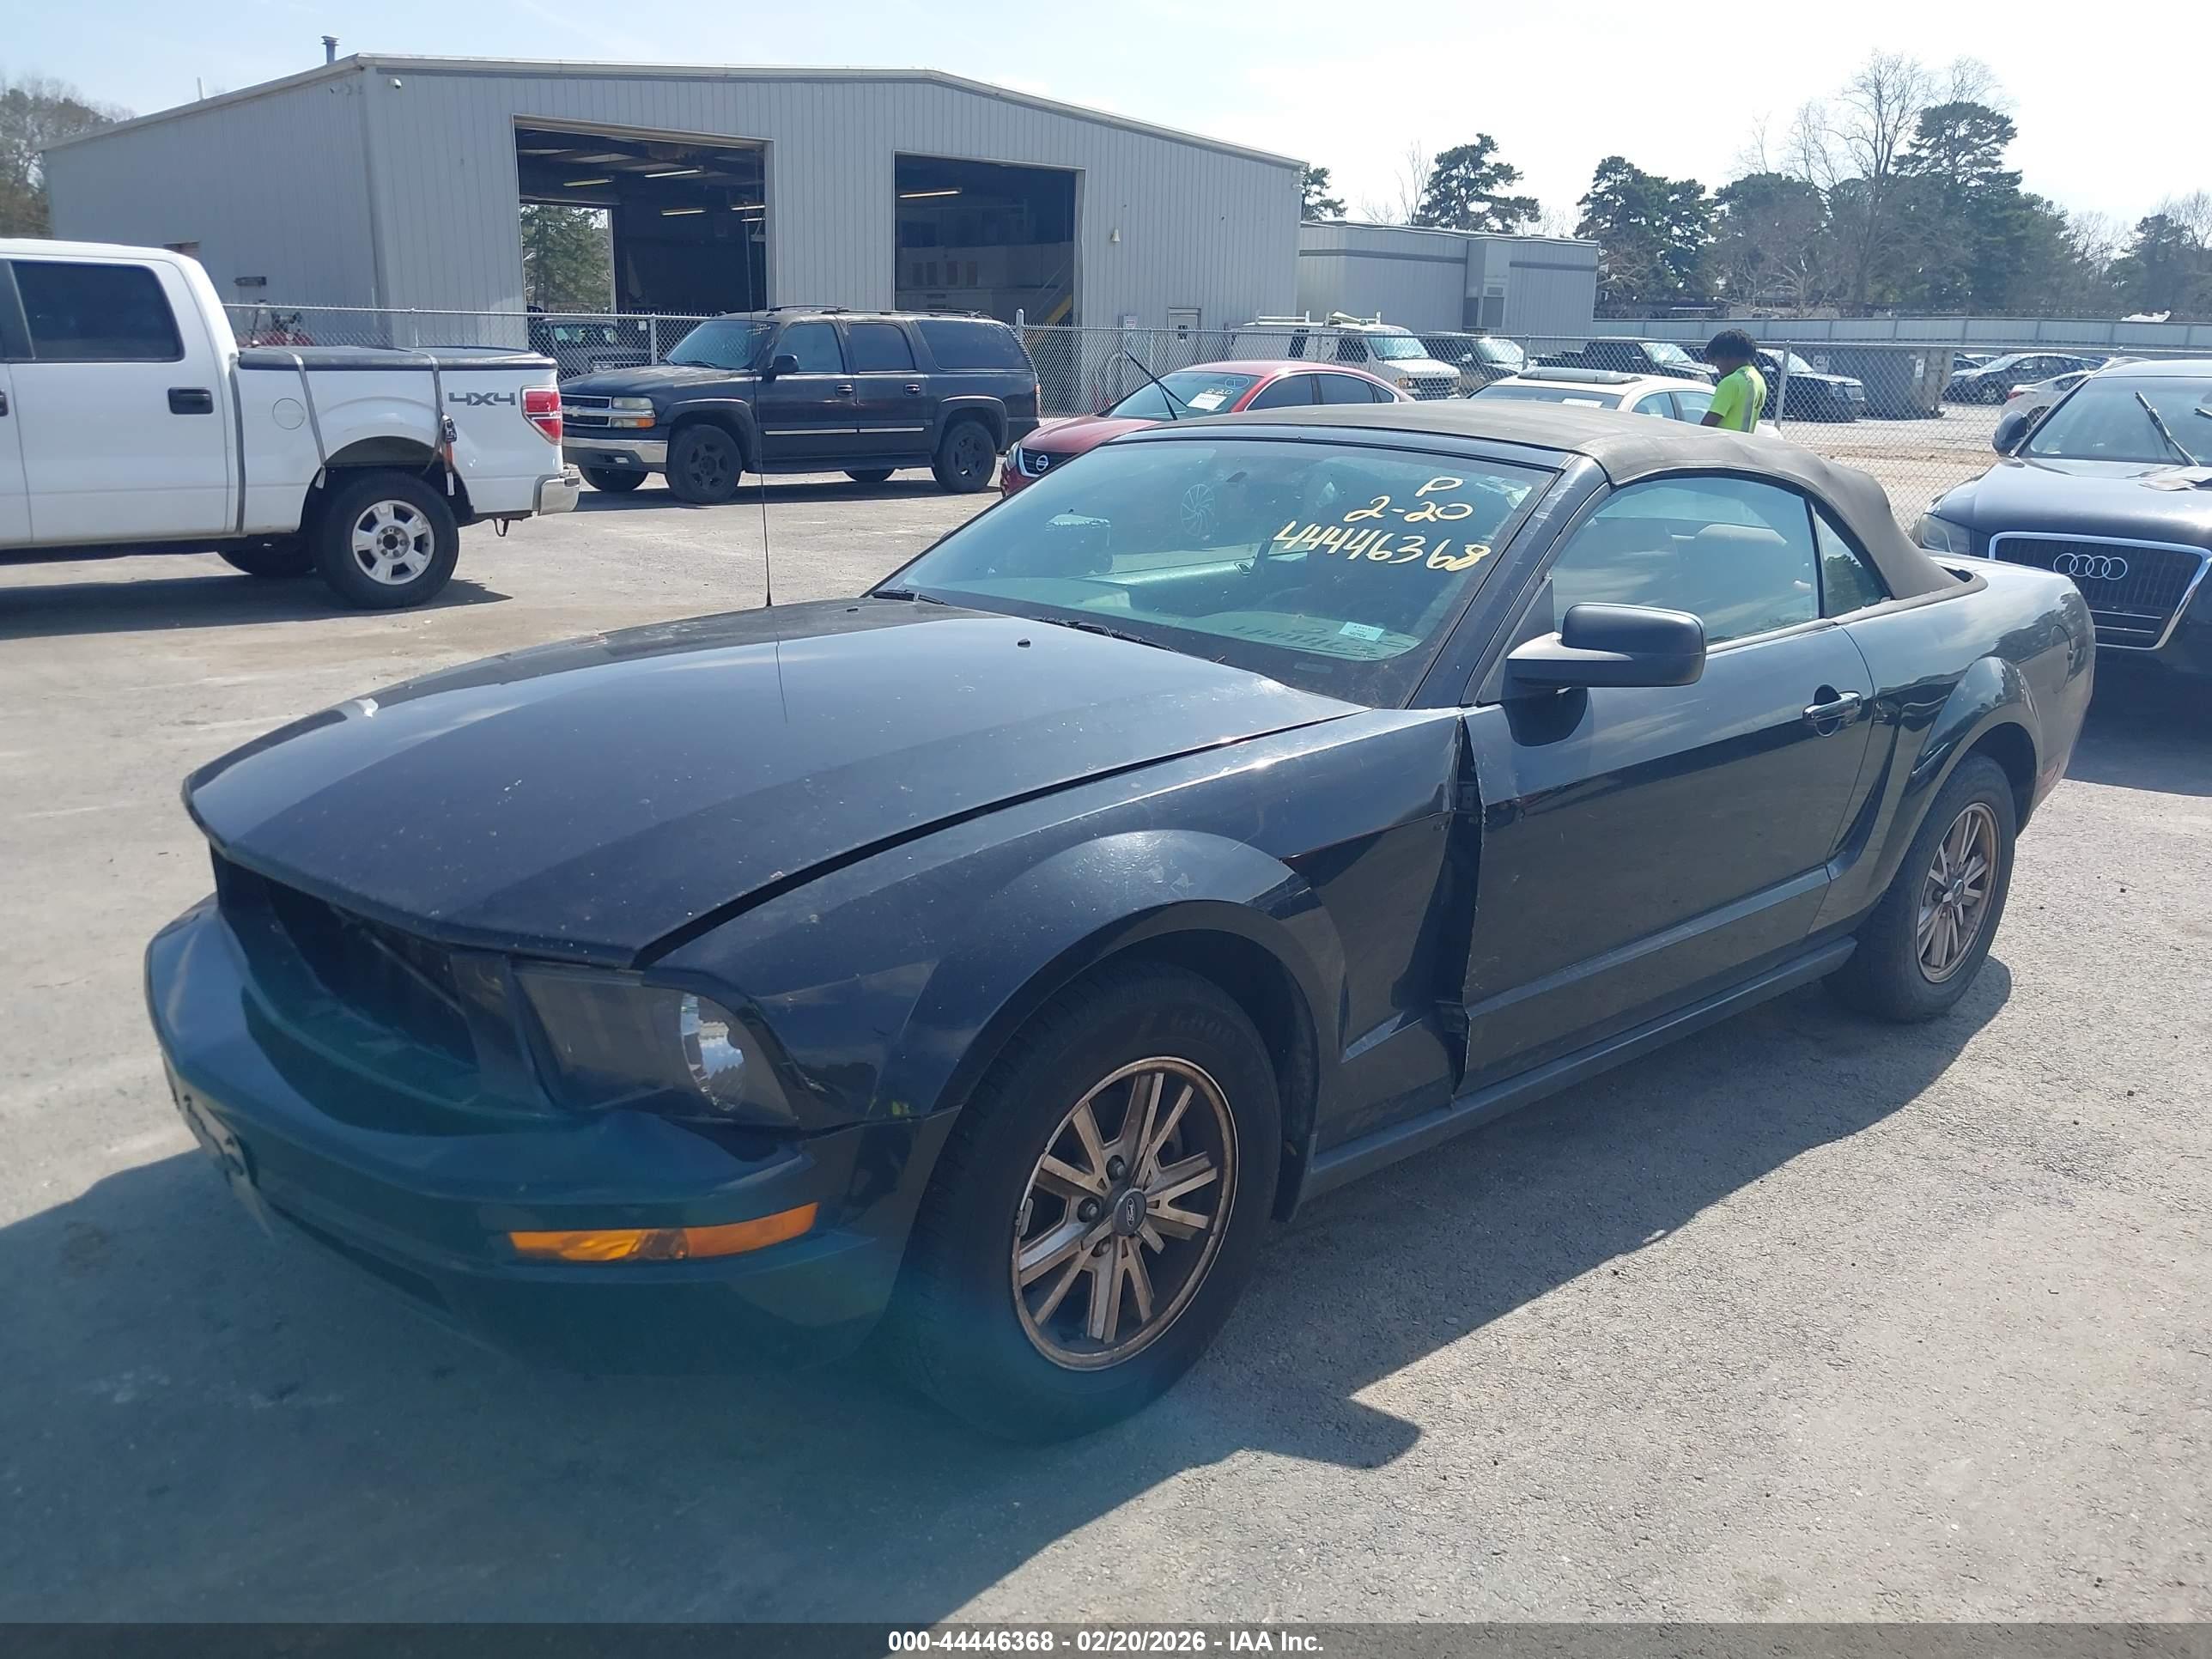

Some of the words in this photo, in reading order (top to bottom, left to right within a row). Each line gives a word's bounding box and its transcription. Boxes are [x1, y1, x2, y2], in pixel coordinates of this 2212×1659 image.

[1415, 476, 1464, 497] P
[1343, 495, 1474, 523] 2-20
[1273, 520, 1492, 572] 44446368
